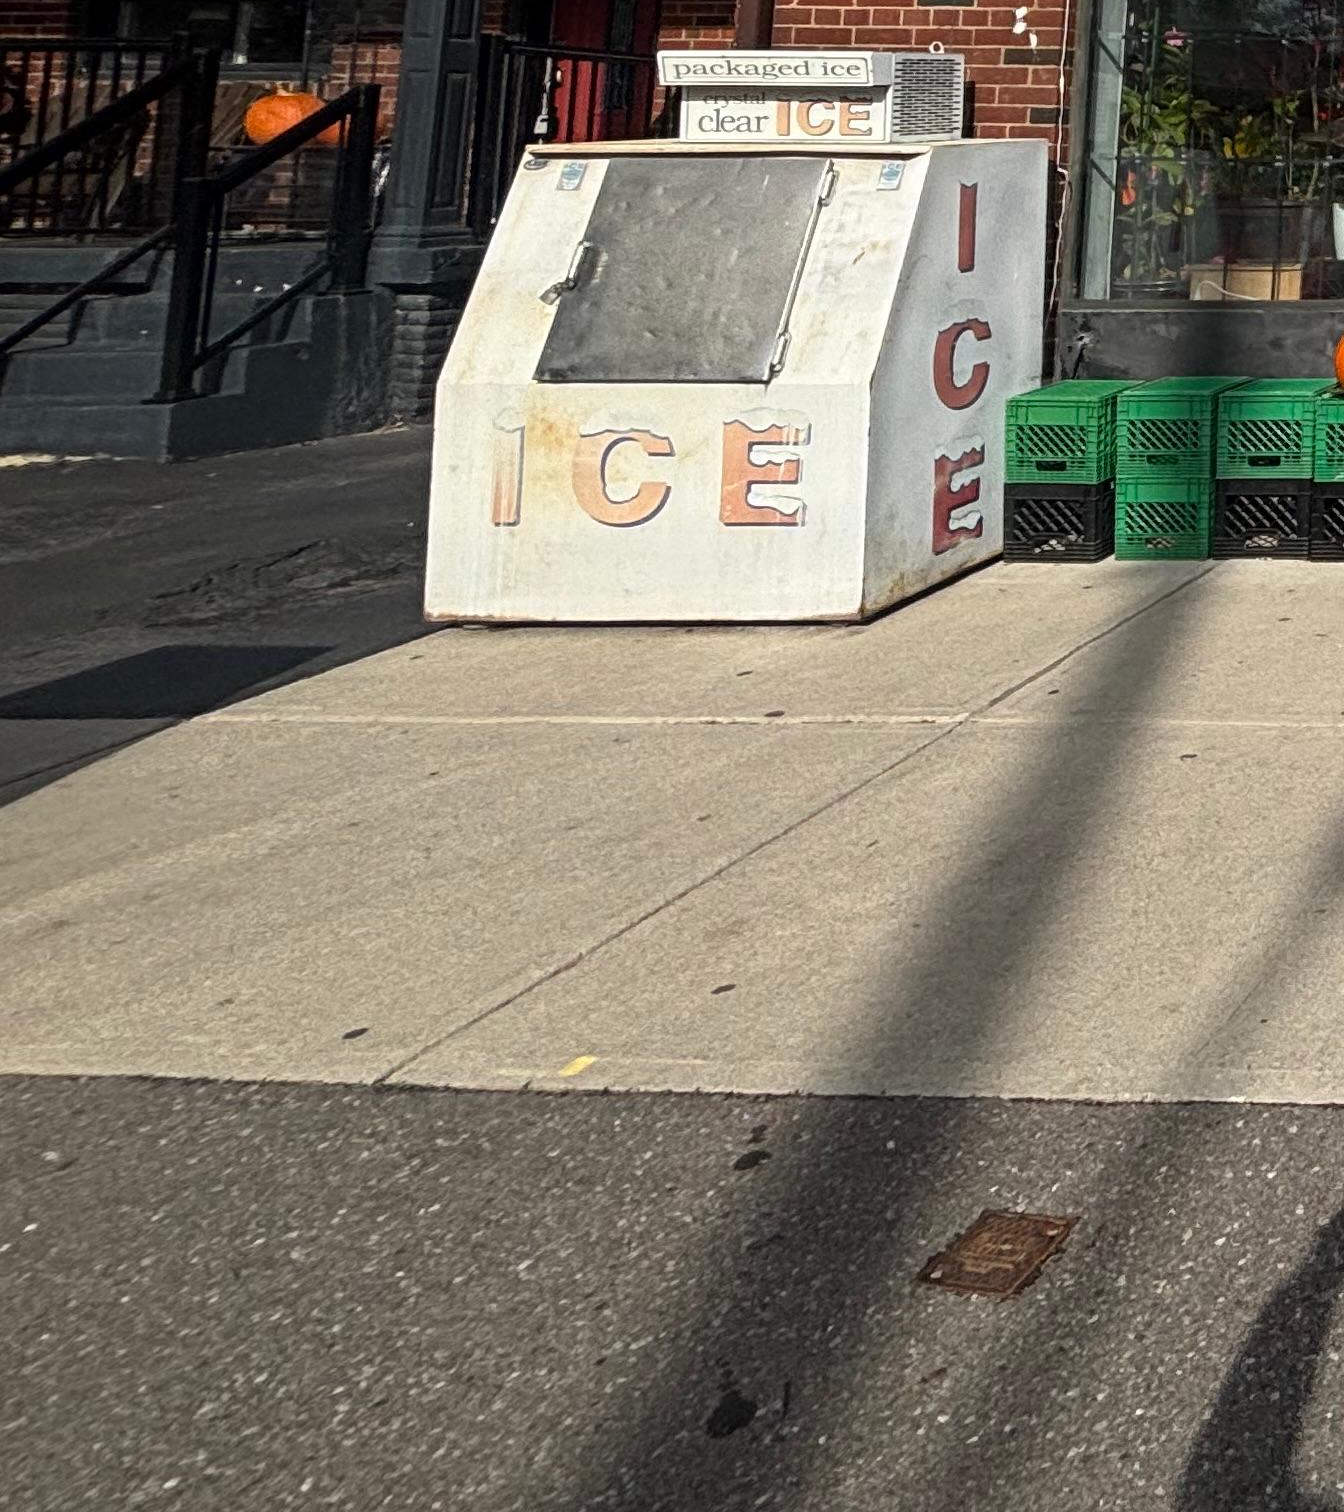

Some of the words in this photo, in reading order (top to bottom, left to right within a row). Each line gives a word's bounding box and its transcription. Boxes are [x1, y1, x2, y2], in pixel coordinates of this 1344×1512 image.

[673, 60, 810, 80] packaged
[822, 62, 861, 76] ice
[703, 92, 766, 108] crystal
[776, 95, 873, 136] ICE
[698, 109, 769, 133] clear
[932, 182, 992, 555] ICE
[491, 407, 810, 527] ICE
